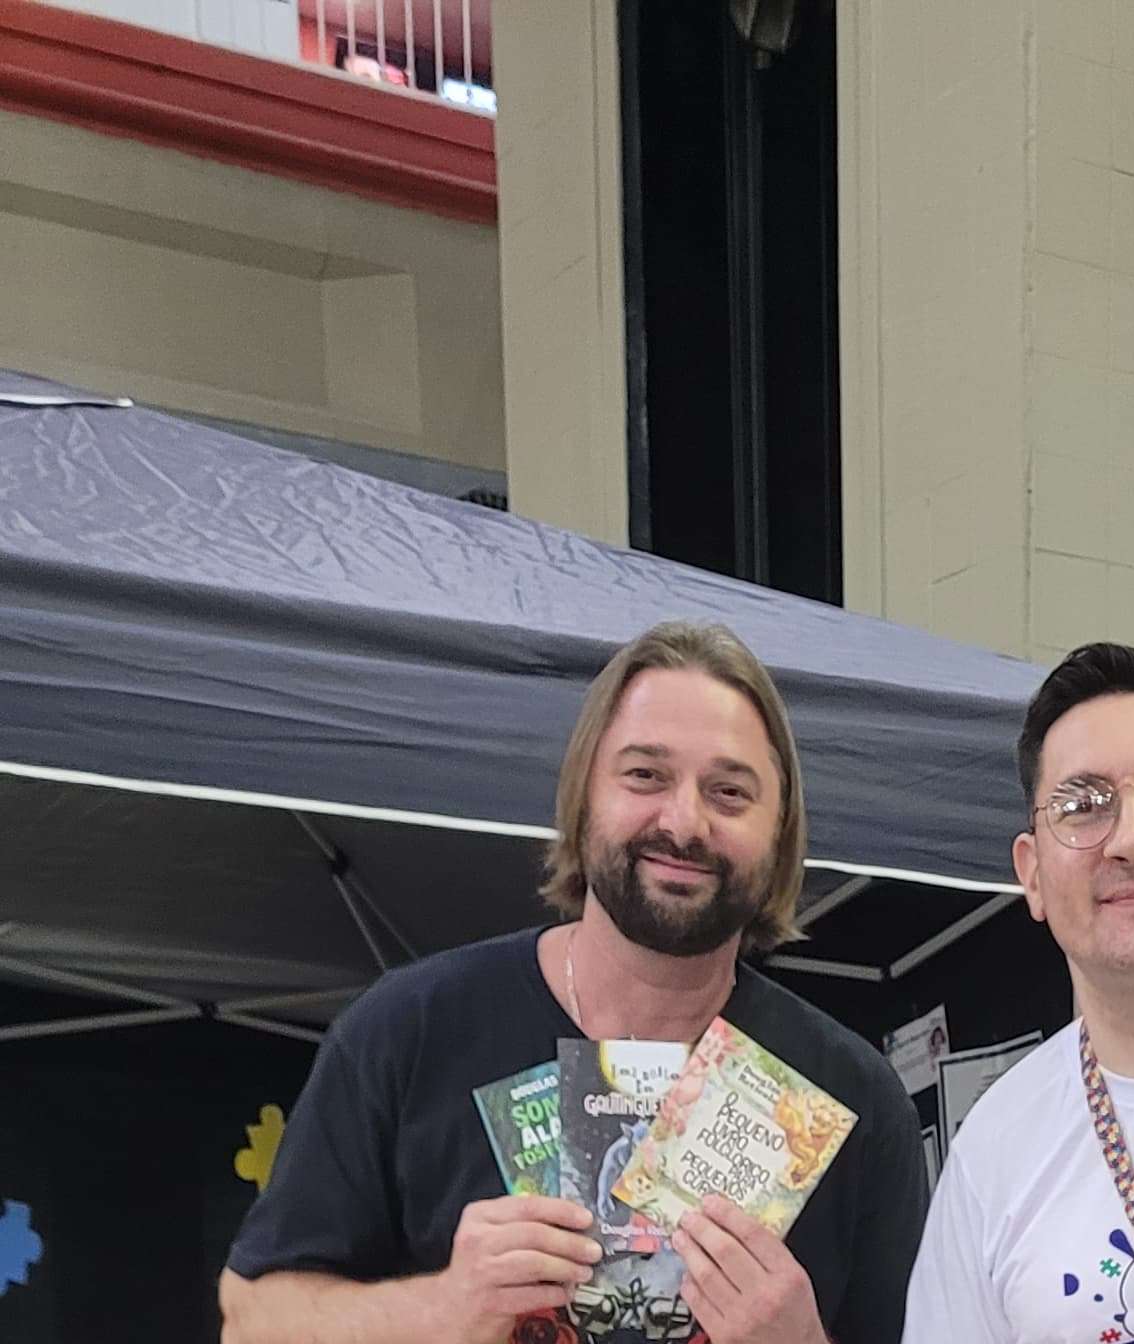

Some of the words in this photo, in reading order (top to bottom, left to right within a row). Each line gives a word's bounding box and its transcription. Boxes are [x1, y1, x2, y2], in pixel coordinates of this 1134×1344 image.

[712, 1119, 749, 1151] LIVRO
[717, 1103, 785, 1152] PEQUENO
[680, 1149, 747, 1201] PEQUENOS
